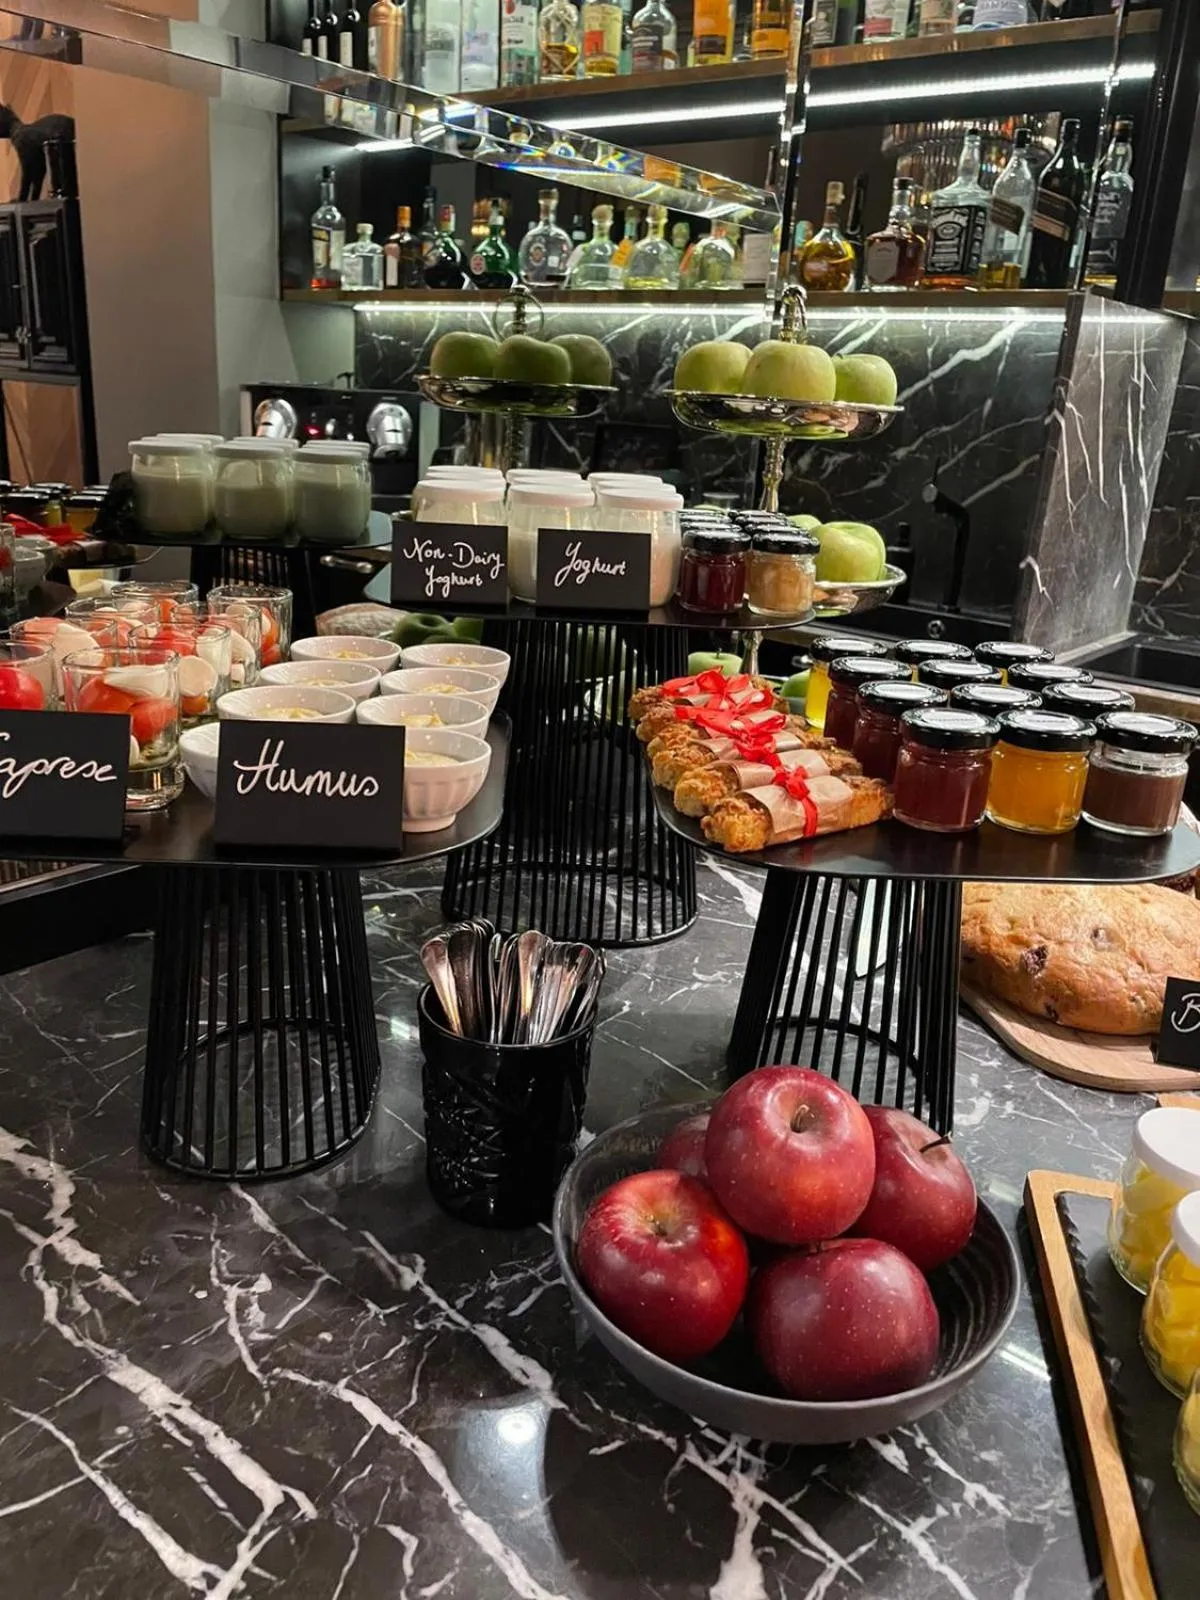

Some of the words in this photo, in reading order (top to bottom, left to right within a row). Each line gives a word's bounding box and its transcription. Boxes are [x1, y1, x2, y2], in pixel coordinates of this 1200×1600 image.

[402, 537, 505, 580] Non-Dairy
[424, 564, 483, 598] Yoghurt
[554, 541, 627, 587] Yoghurt
[0, 731, 118, 799] aprese
[232, 738, 380, 798] Humus
